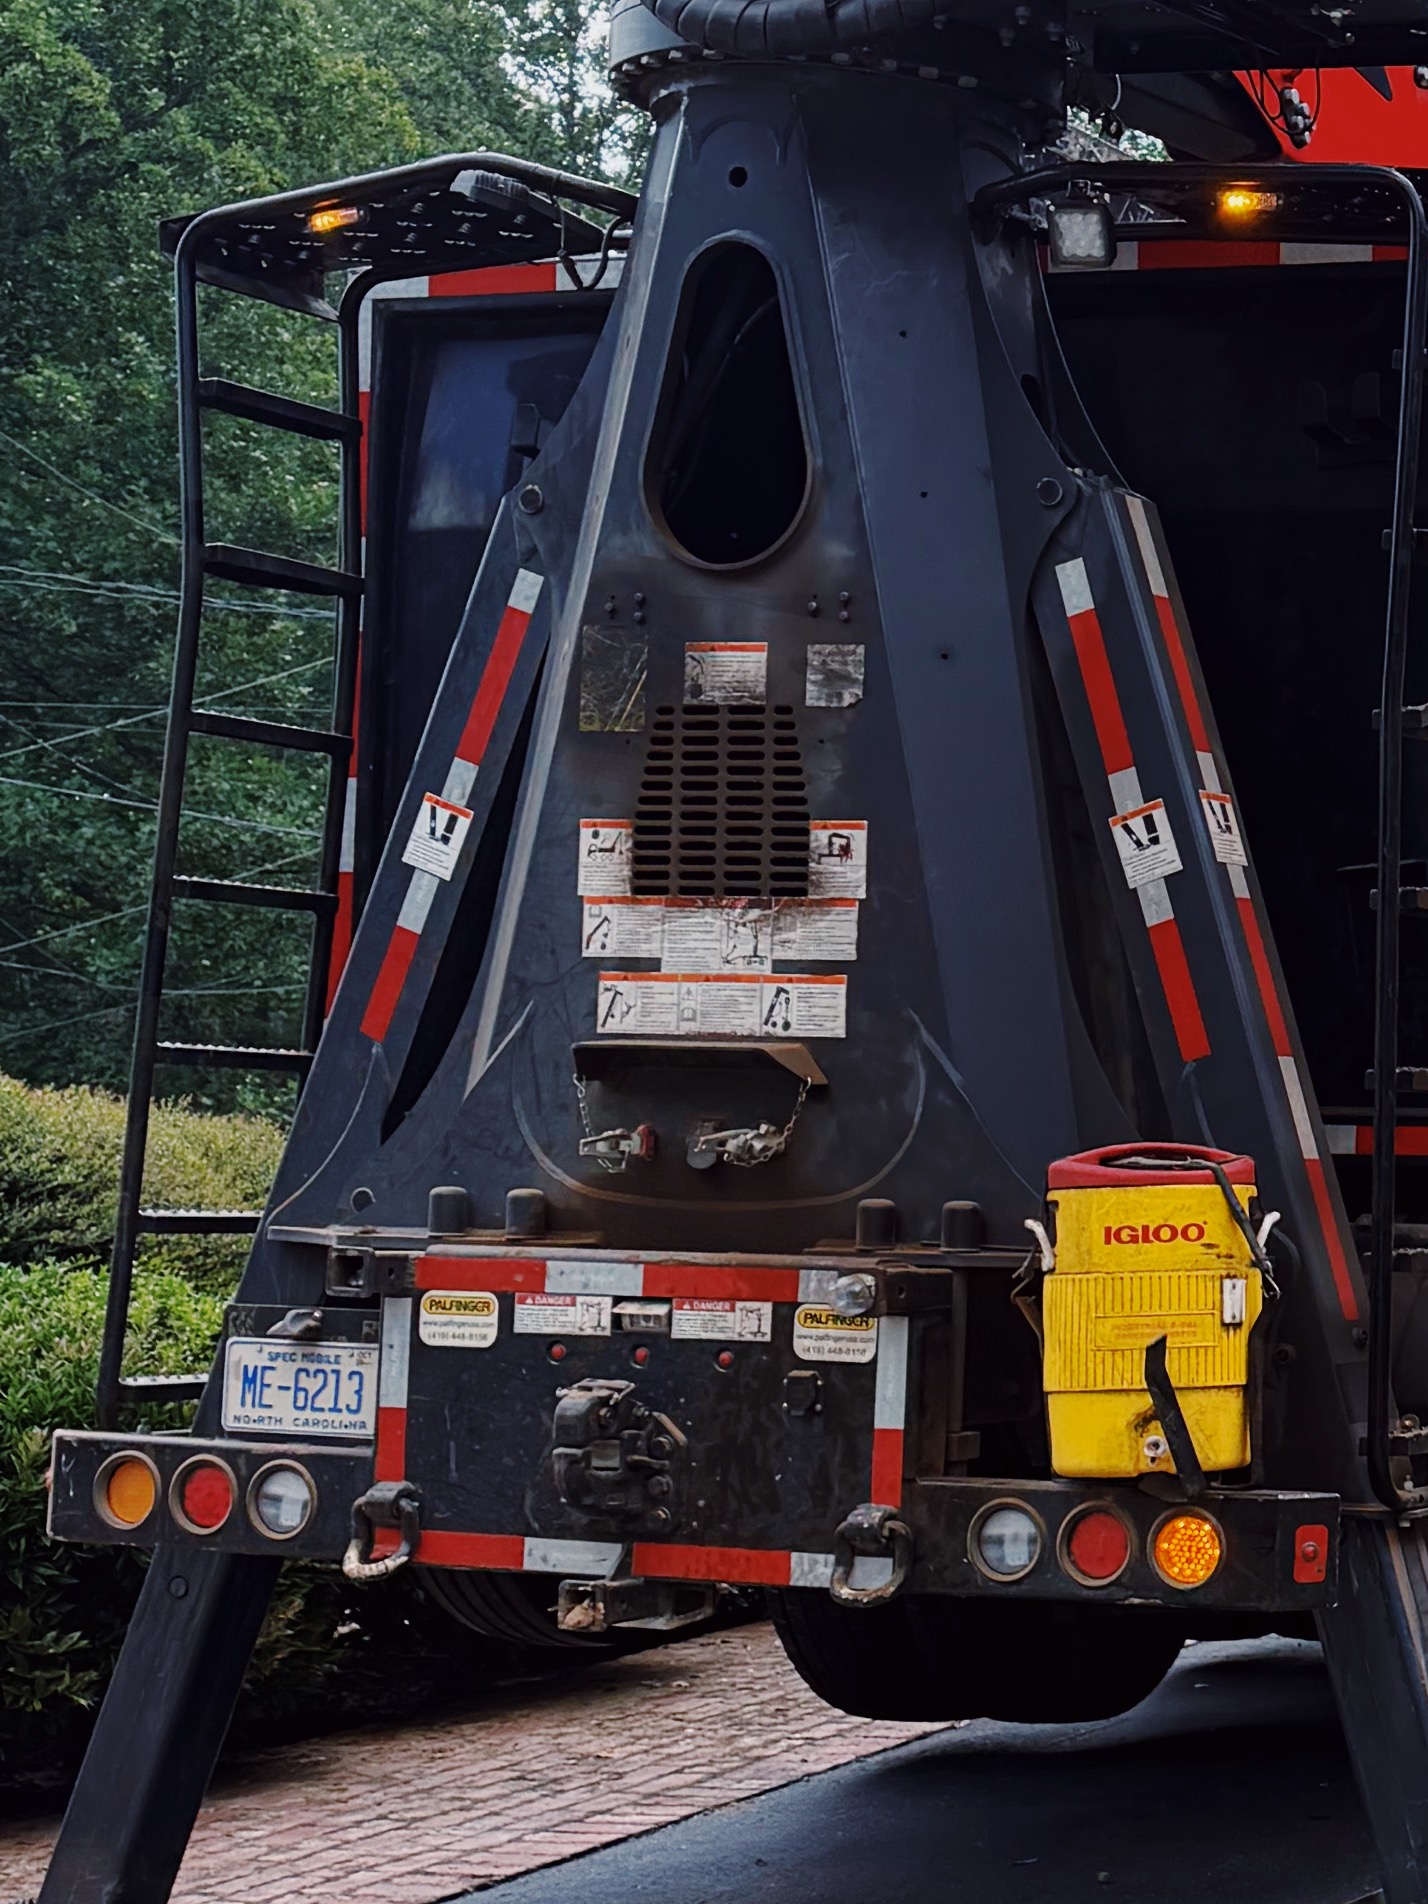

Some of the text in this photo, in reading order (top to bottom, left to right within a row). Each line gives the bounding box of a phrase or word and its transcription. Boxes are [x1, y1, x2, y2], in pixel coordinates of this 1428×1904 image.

[1103, 1223, 1206, 1246] IGLOO
[429, 1298, 491, 1313] PALFINGER
[692, 1301, 731, 1311] DANGER
[267, 1351, 297, 1363] SPEC
[240, 1364, 364, 1416] ME-6213
[233, 1415, 368, 1430] NORTH CAROLINA
